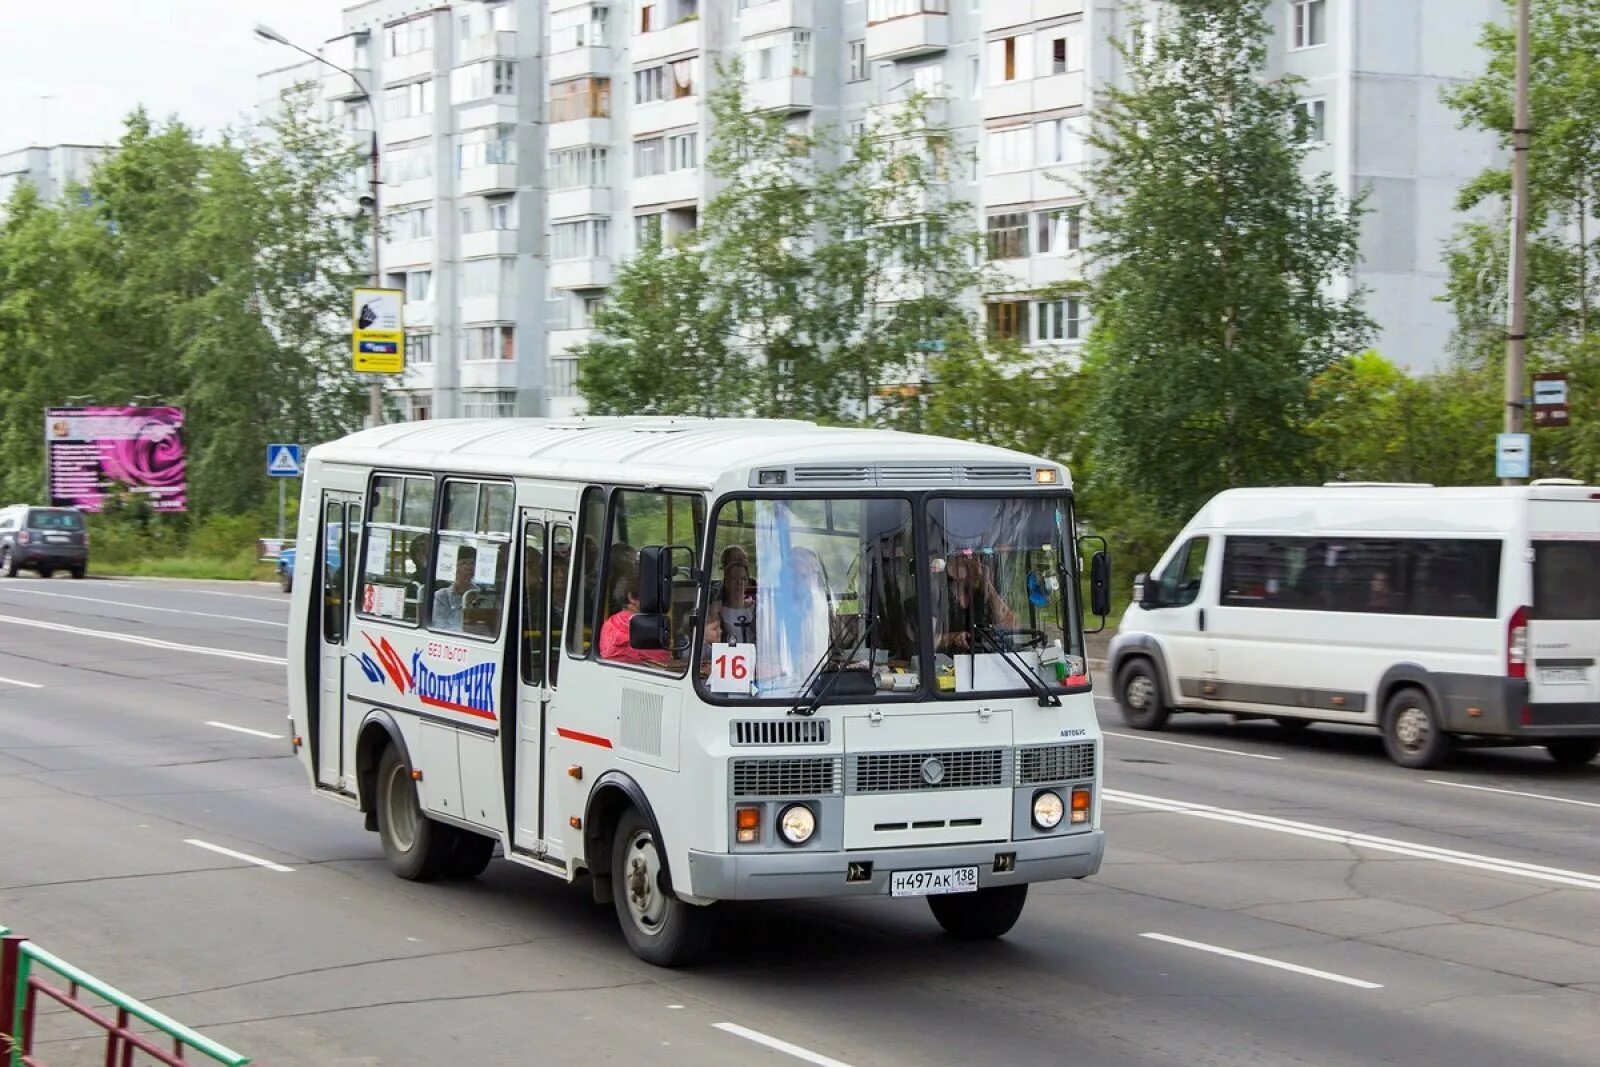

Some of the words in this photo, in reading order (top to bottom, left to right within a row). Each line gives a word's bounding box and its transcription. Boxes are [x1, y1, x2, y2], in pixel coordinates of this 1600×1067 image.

[428, 642, 442, 659] БЕЗ
[715, 655, 747, 679] 16
[419, 661, 496, 713] ПОПУТЧИК
[896, 872, 951, 890] Н497АК
[955, 869, 975, 882] 138
